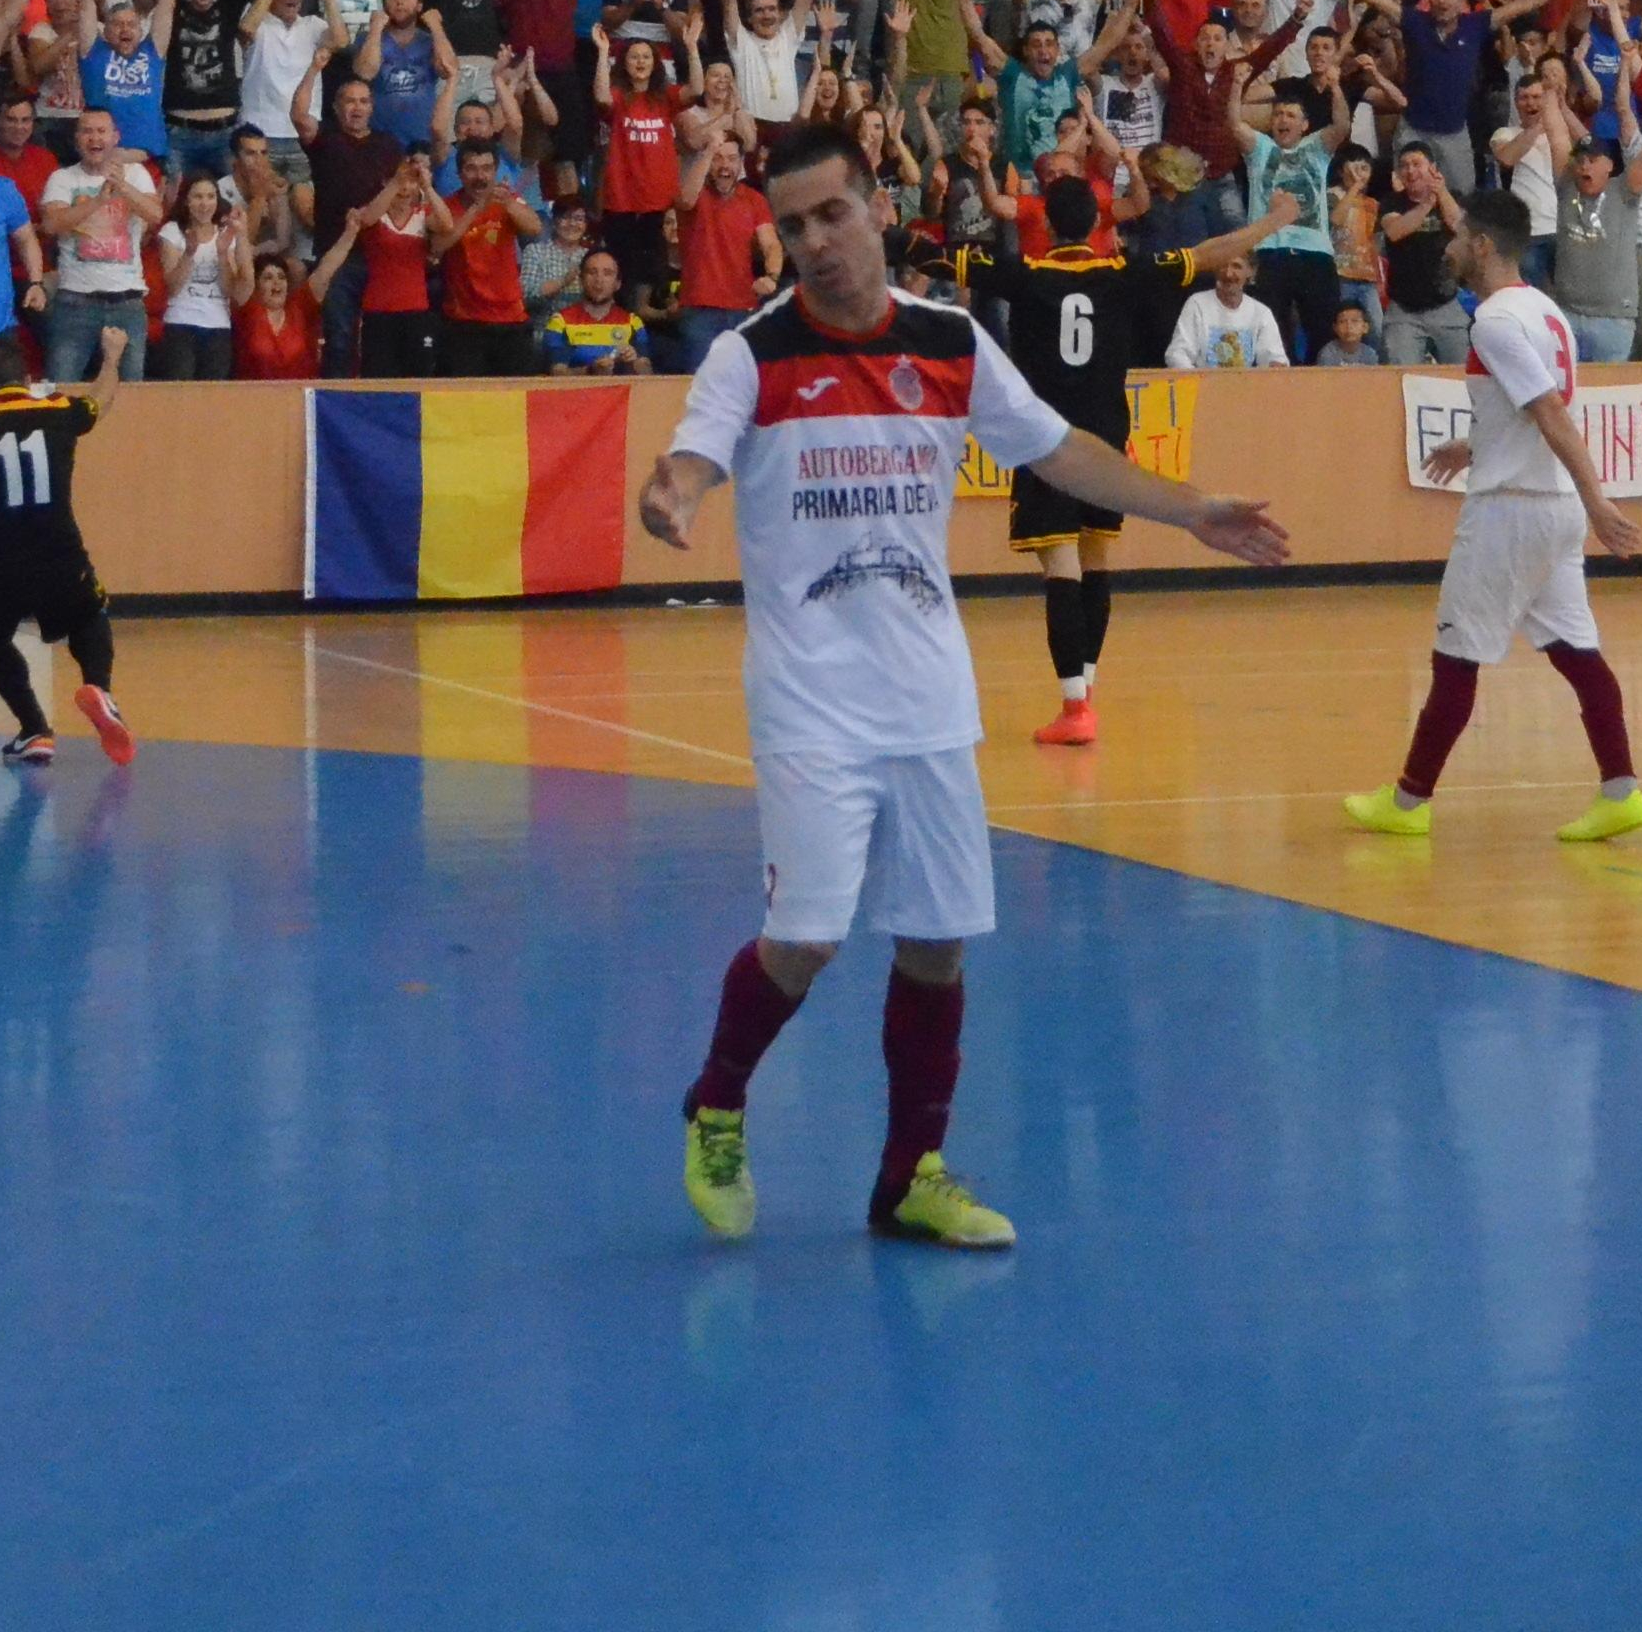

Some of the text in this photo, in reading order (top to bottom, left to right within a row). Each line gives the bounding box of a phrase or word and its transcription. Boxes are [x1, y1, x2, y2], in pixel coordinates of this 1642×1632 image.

[1059, 292, 1094, 366] 6
[1543, 314, 1573, 407] 3
[793, 485, 897, 520] PRIMARIA
